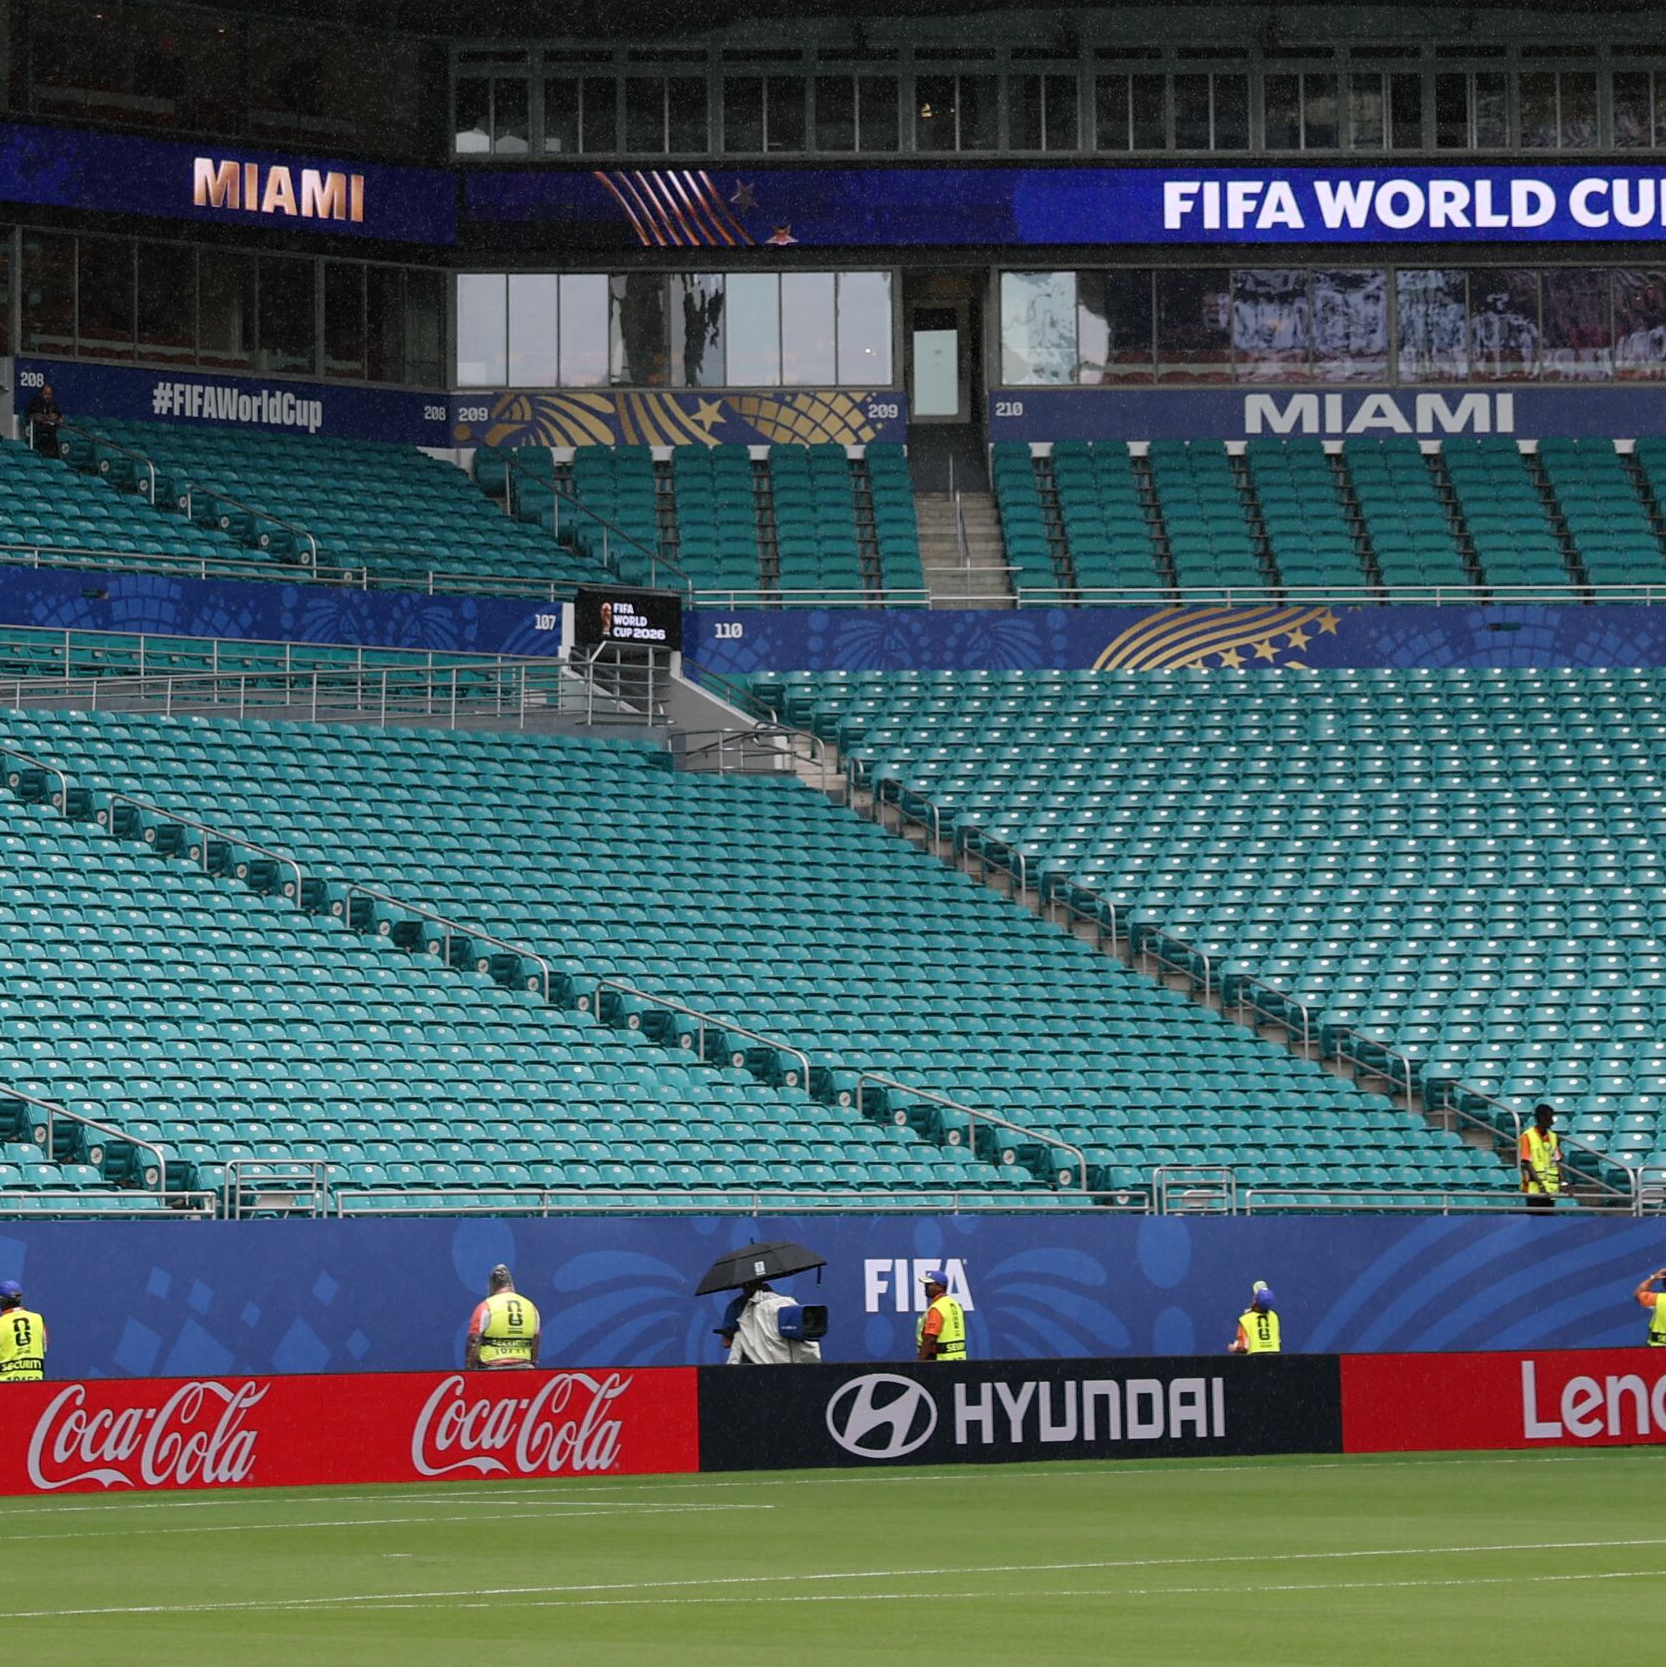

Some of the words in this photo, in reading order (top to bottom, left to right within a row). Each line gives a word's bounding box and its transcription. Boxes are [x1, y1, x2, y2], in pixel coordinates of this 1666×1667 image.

[194, 157, 364, 221] MIAMI
[1164, 181, 1304, 229] FIFA
[1314, 180, 1556, 228] WORLD
[20, 371, 45, 388] 208
[153, 382, 322, 433] #FIFAWorldCup
[423, 405, 447, 422] 208
[458, 407, 489, 422] 209
[868, 403, 899, 419] 209
[995, 401, 1024, 417] 210
[1245, 394, 1513, 433] MIAMI
[613, 602, 635, 615] FIFA
[534, 613, 557, 631] 107
[613, 615, 648, 627] WORLD
[613, 627, 632, 638] CUP
[633, 628, 666, 640] 2026
[714, 622, 743, 639] 110
[864, 1258, 975, 1312] FIFA
[955, 1378, 1225, 1444] HYUNDAI
[411, 1372, 633, 1476] Coca-Cola
[27, 1380, 270, 1490] Coca-Cola
